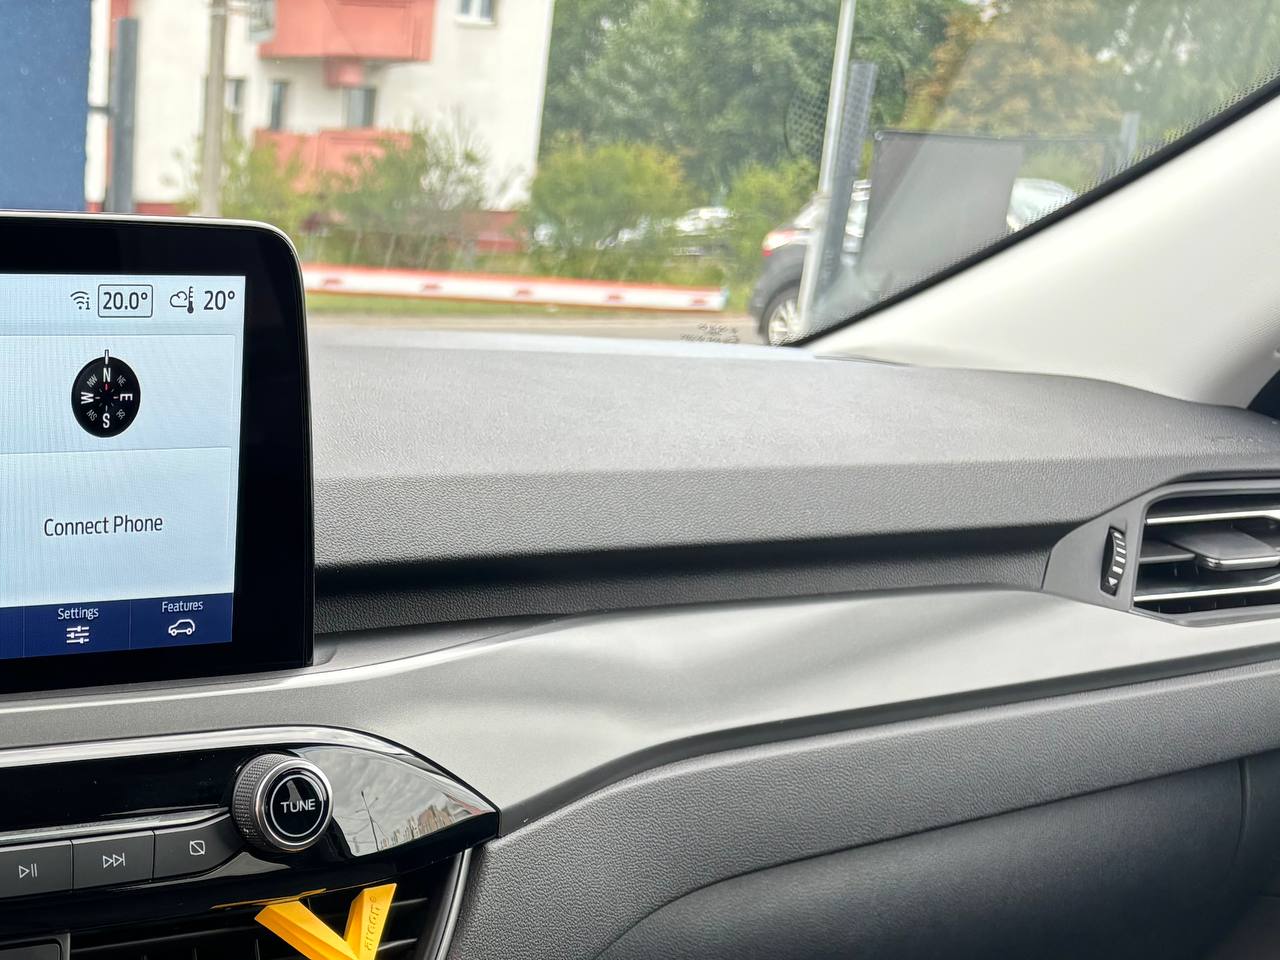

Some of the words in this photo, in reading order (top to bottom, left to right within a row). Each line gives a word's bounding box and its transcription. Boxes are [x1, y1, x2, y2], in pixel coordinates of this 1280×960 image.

[103, 291, 148, 310] 20.0°
[203, 290, 235, 310] 20°
[103, 367, 111, 383] N
[81, 391, 94, 405] W
[120, 393, 133, 402] E
[102, 412, 111, 429] S
[43, 516, 109, 537] Connect
[113, 514, 163, 534] Phone
[57, 607, 99, 621] Settings
[161, 600, 204, 613] Features
[280, 798, 316, 814] TUNE
